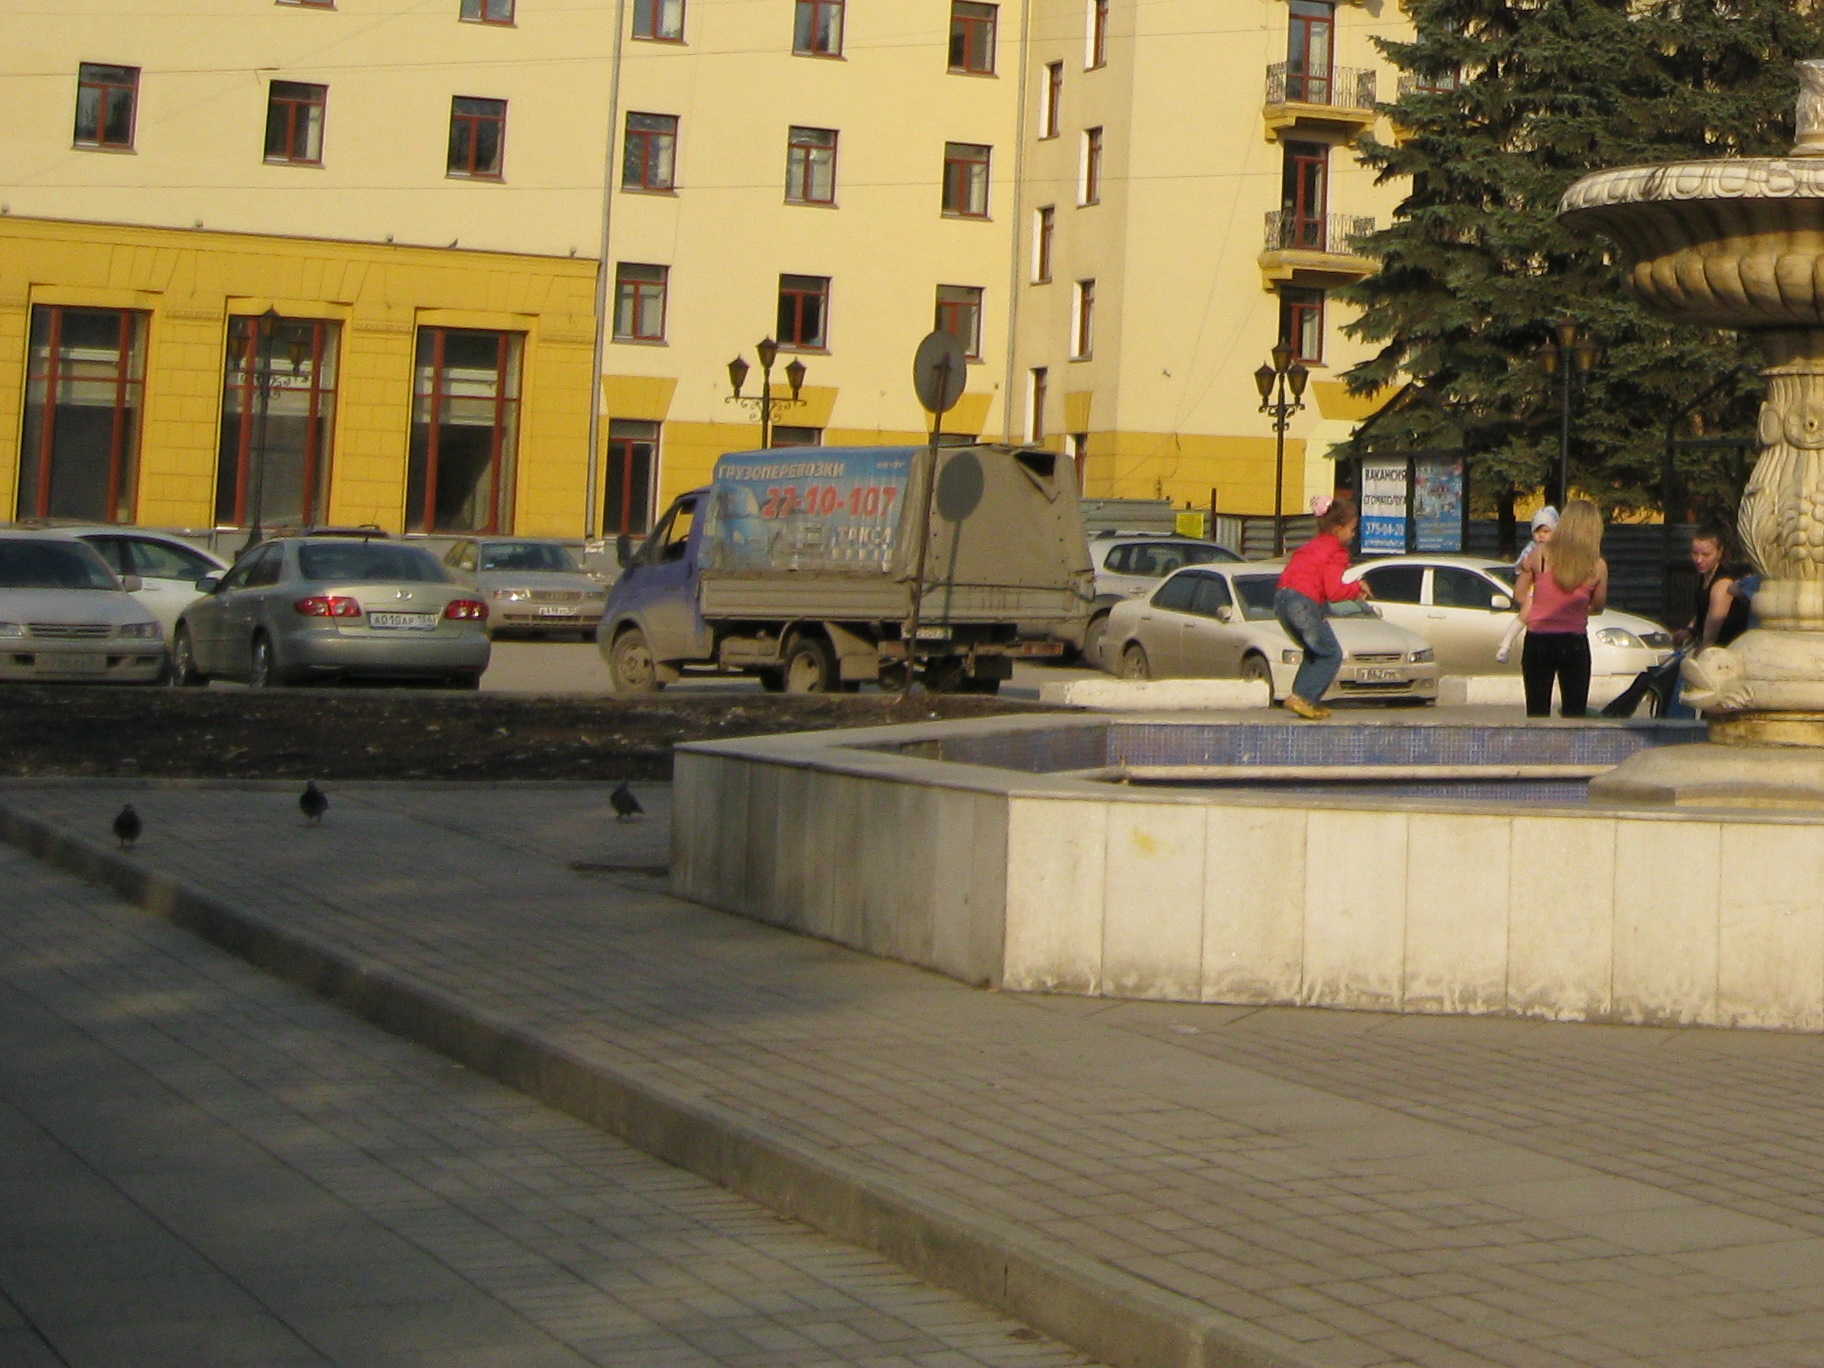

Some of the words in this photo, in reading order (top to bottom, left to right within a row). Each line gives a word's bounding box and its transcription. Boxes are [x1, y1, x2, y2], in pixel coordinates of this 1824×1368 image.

[718, 463, 845, 480] ГРУЗОПЕРЕВОЗКИ
[1365, 469, 1407, 481] ВАКАНСИЯ
[761, 484, 898, 518] 27-10-107
